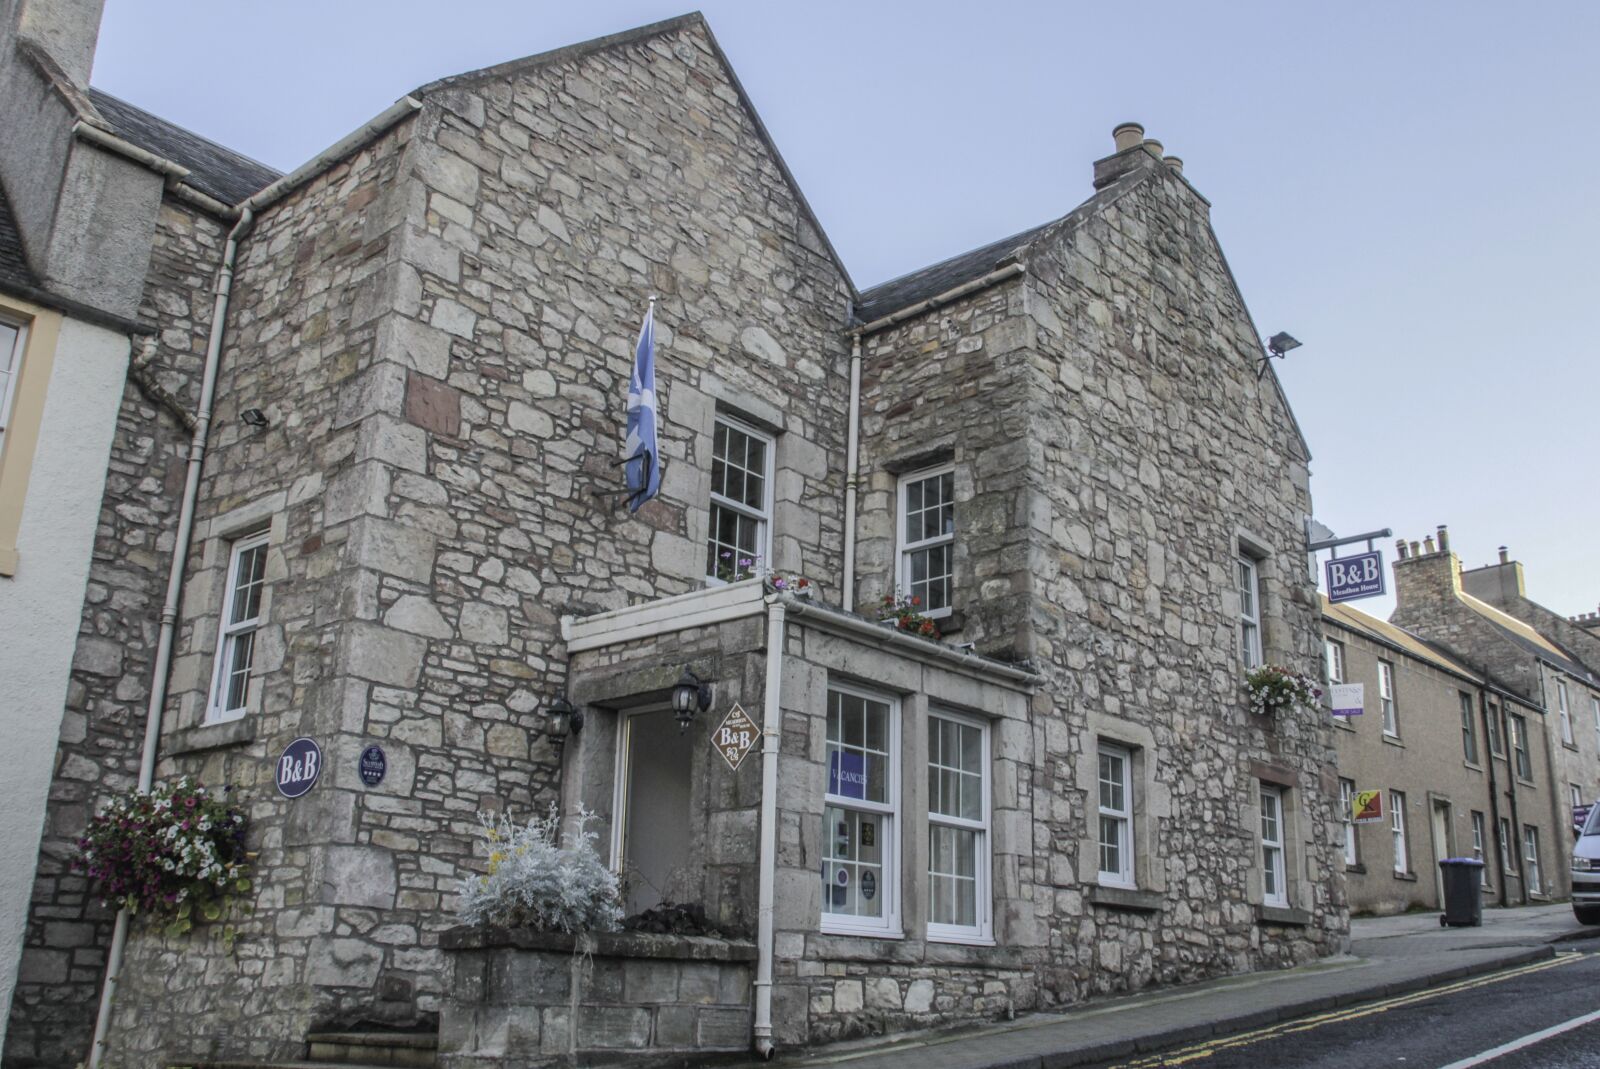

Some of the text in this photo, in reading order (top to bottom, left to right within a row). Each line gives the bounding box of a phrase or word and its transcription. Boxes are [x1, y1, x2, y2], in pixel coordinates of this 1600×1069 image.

[1330, 557, 1379, 588] B&B
[1360, 583, 1379, 592] House
[720, 727, 750, 750] B&B
[280, 750, 317, 785] B&B
